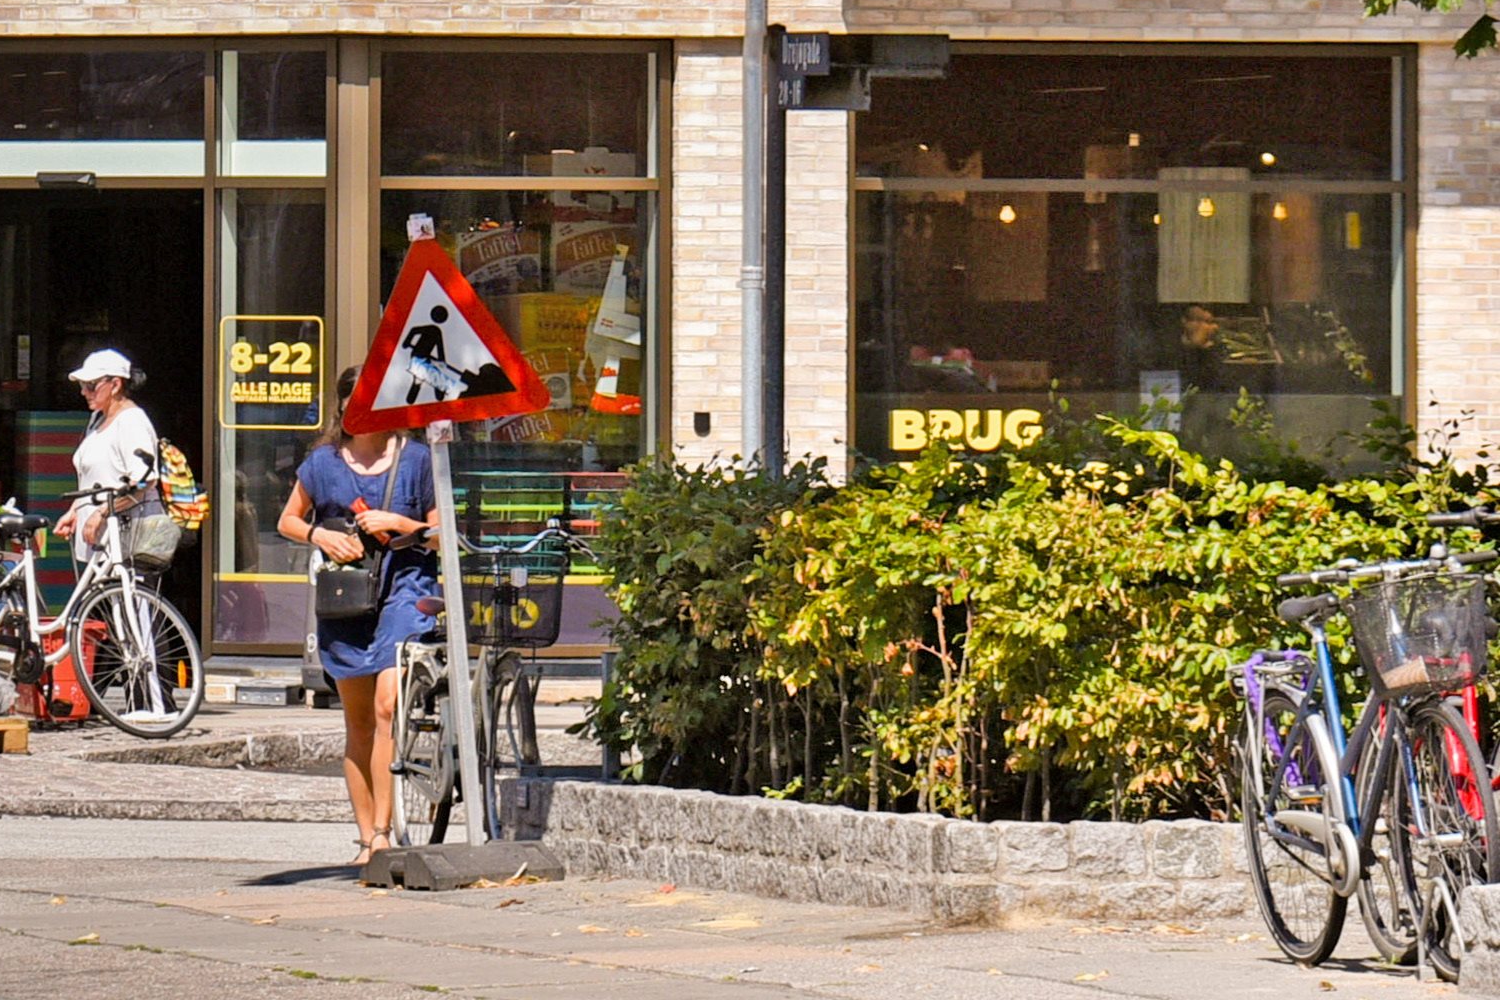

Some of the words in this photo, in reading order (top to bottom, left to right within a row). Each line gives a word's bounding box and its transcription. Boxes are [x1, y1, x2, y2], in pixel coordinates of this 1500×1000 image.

[230, 341, 312, 374] 8-22
[230, 381, 268, 396] ALLE
[269, 381, 312, 396] DAGE
